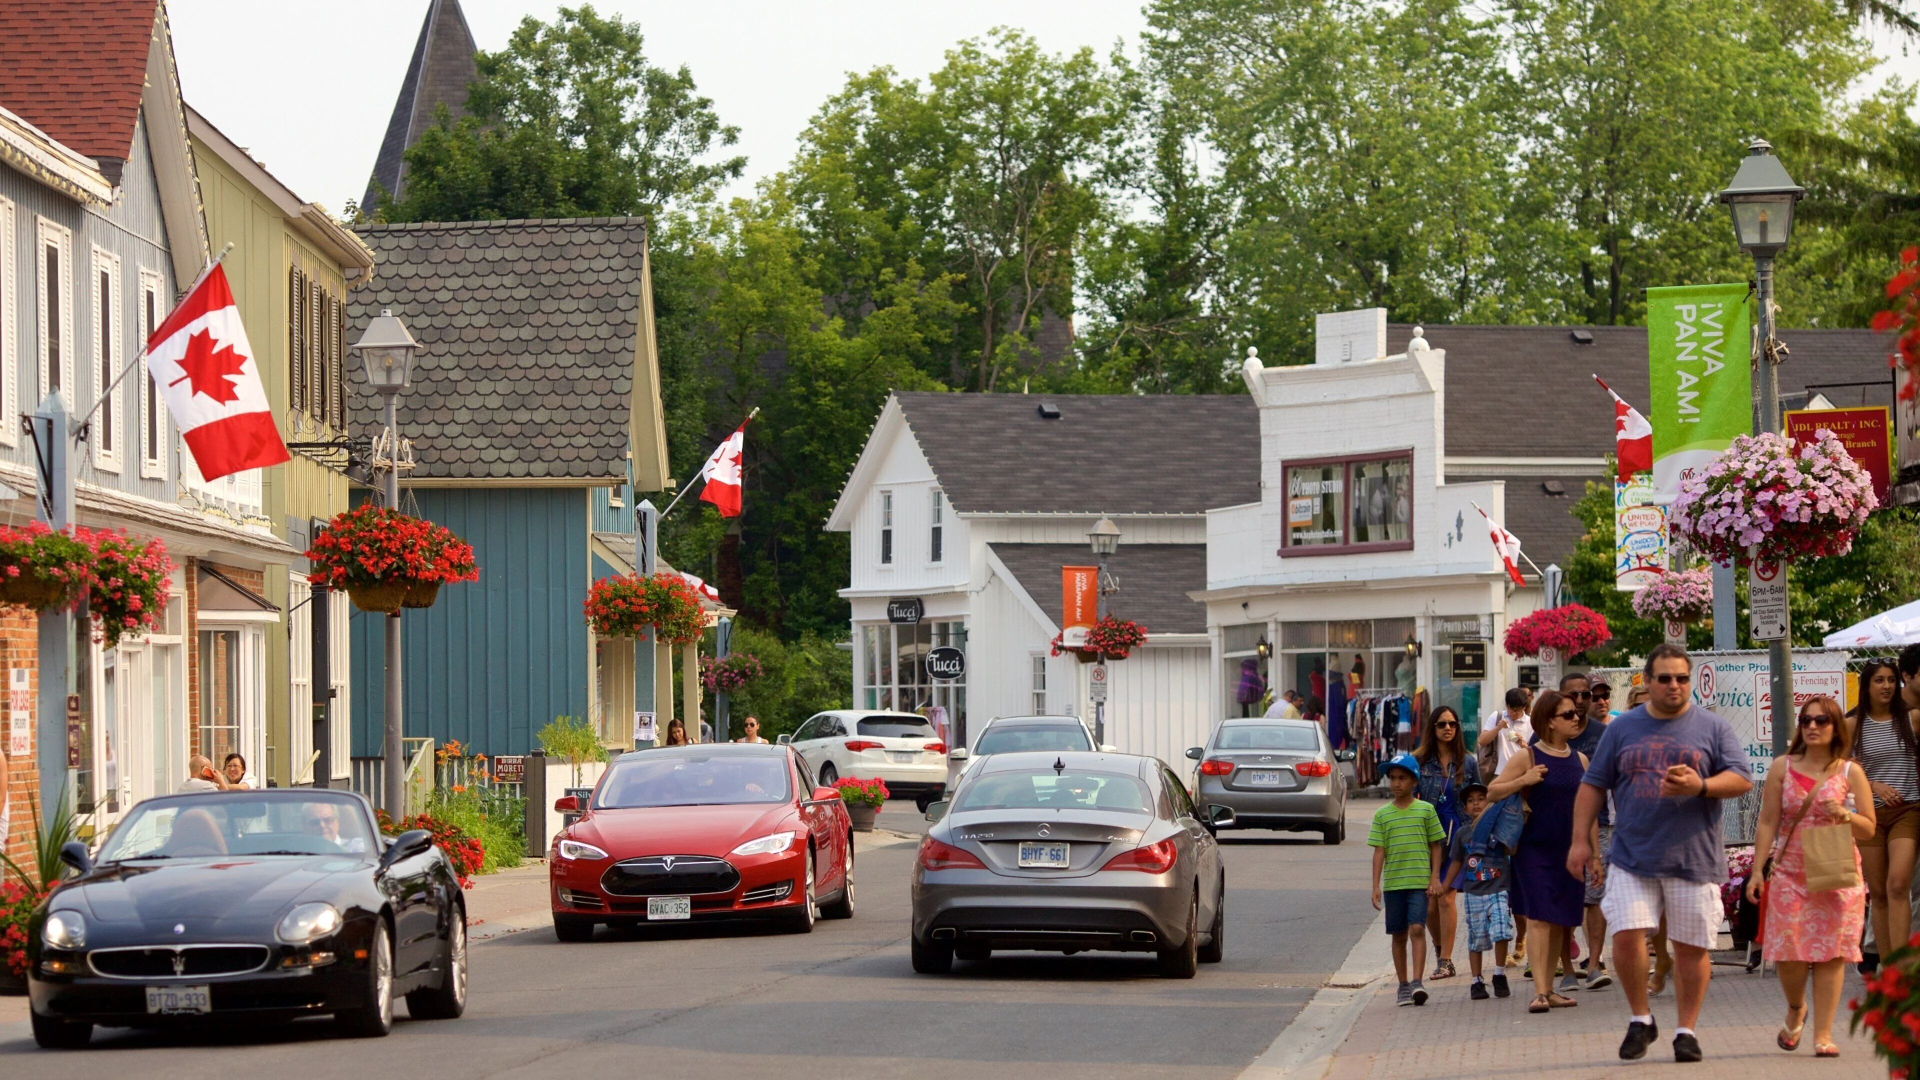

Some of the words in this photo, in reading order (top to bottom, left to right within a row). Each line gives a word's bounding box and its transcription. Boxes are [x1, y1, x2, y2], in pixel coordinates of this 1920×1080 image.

[1674, 304, 1698, 361] PAN
[1676, 370, 1700, 423] AM!
[1794, 422, 1813, 432] JDL
[1815, 421, 1855, 430] REALT
[1859, 420, 1881, 429] INC.
[1845, 439, 1877, 448] Branch
[1302, 481, 1320, 495] PHOTO
[1321, 480, 1343, 493] STUDIO
[1627, 513, 1657, 521] UNITED
[889, 603, 916, 618] Tucci
[928, 653, 961, 672] Tucci
[1801, 674, 1828, 686] Fencing
[1831, 674, 1839, 685] by
